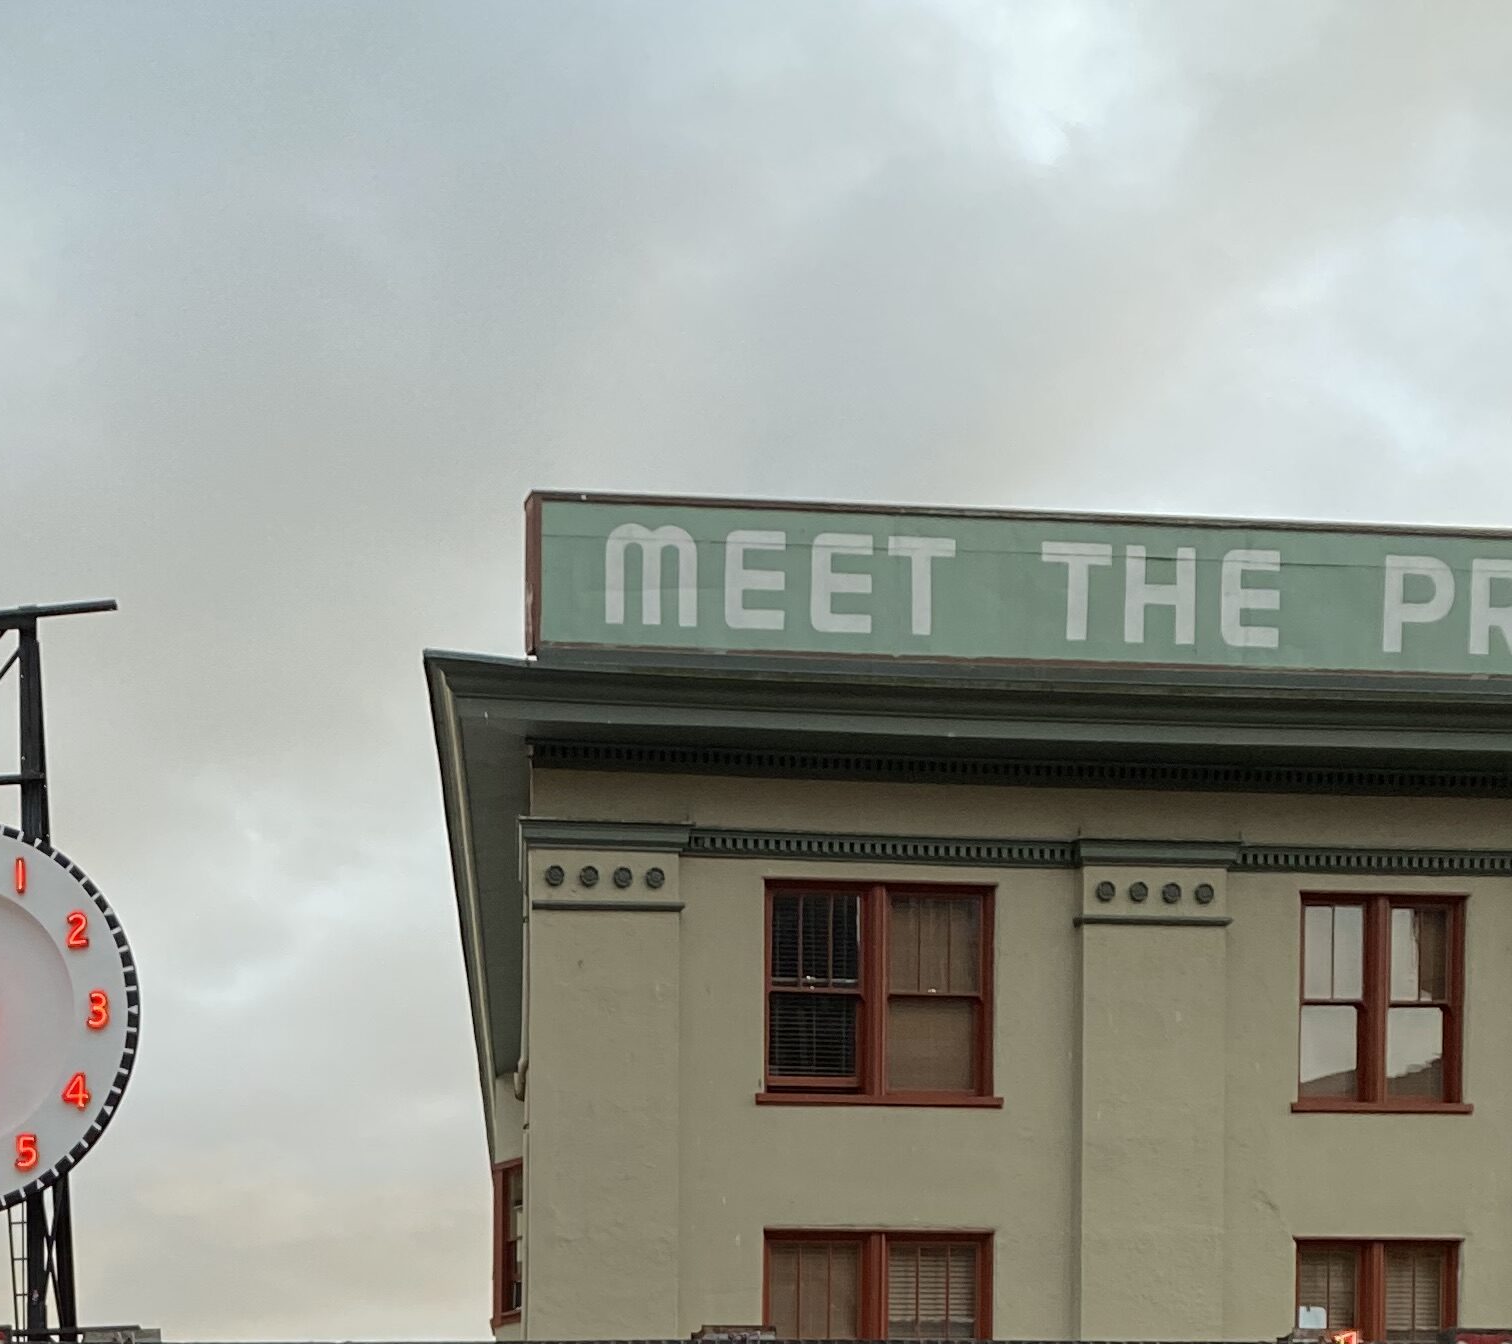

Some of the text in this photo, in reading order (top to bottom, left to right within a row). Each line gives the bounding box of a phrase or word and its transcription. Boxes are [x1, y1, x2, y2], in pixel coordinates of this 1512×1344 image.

[604, 522, 958, 637] MEET
[1041, 539, 1282, 649] THE
[14, 857, 26, 894] 1
[66, 911, 90, 950] 2
[87, 990, 110, 1030] 3
[61, 1071, 91, 1111] 4
[14, 1132, 39, 1172] 5
